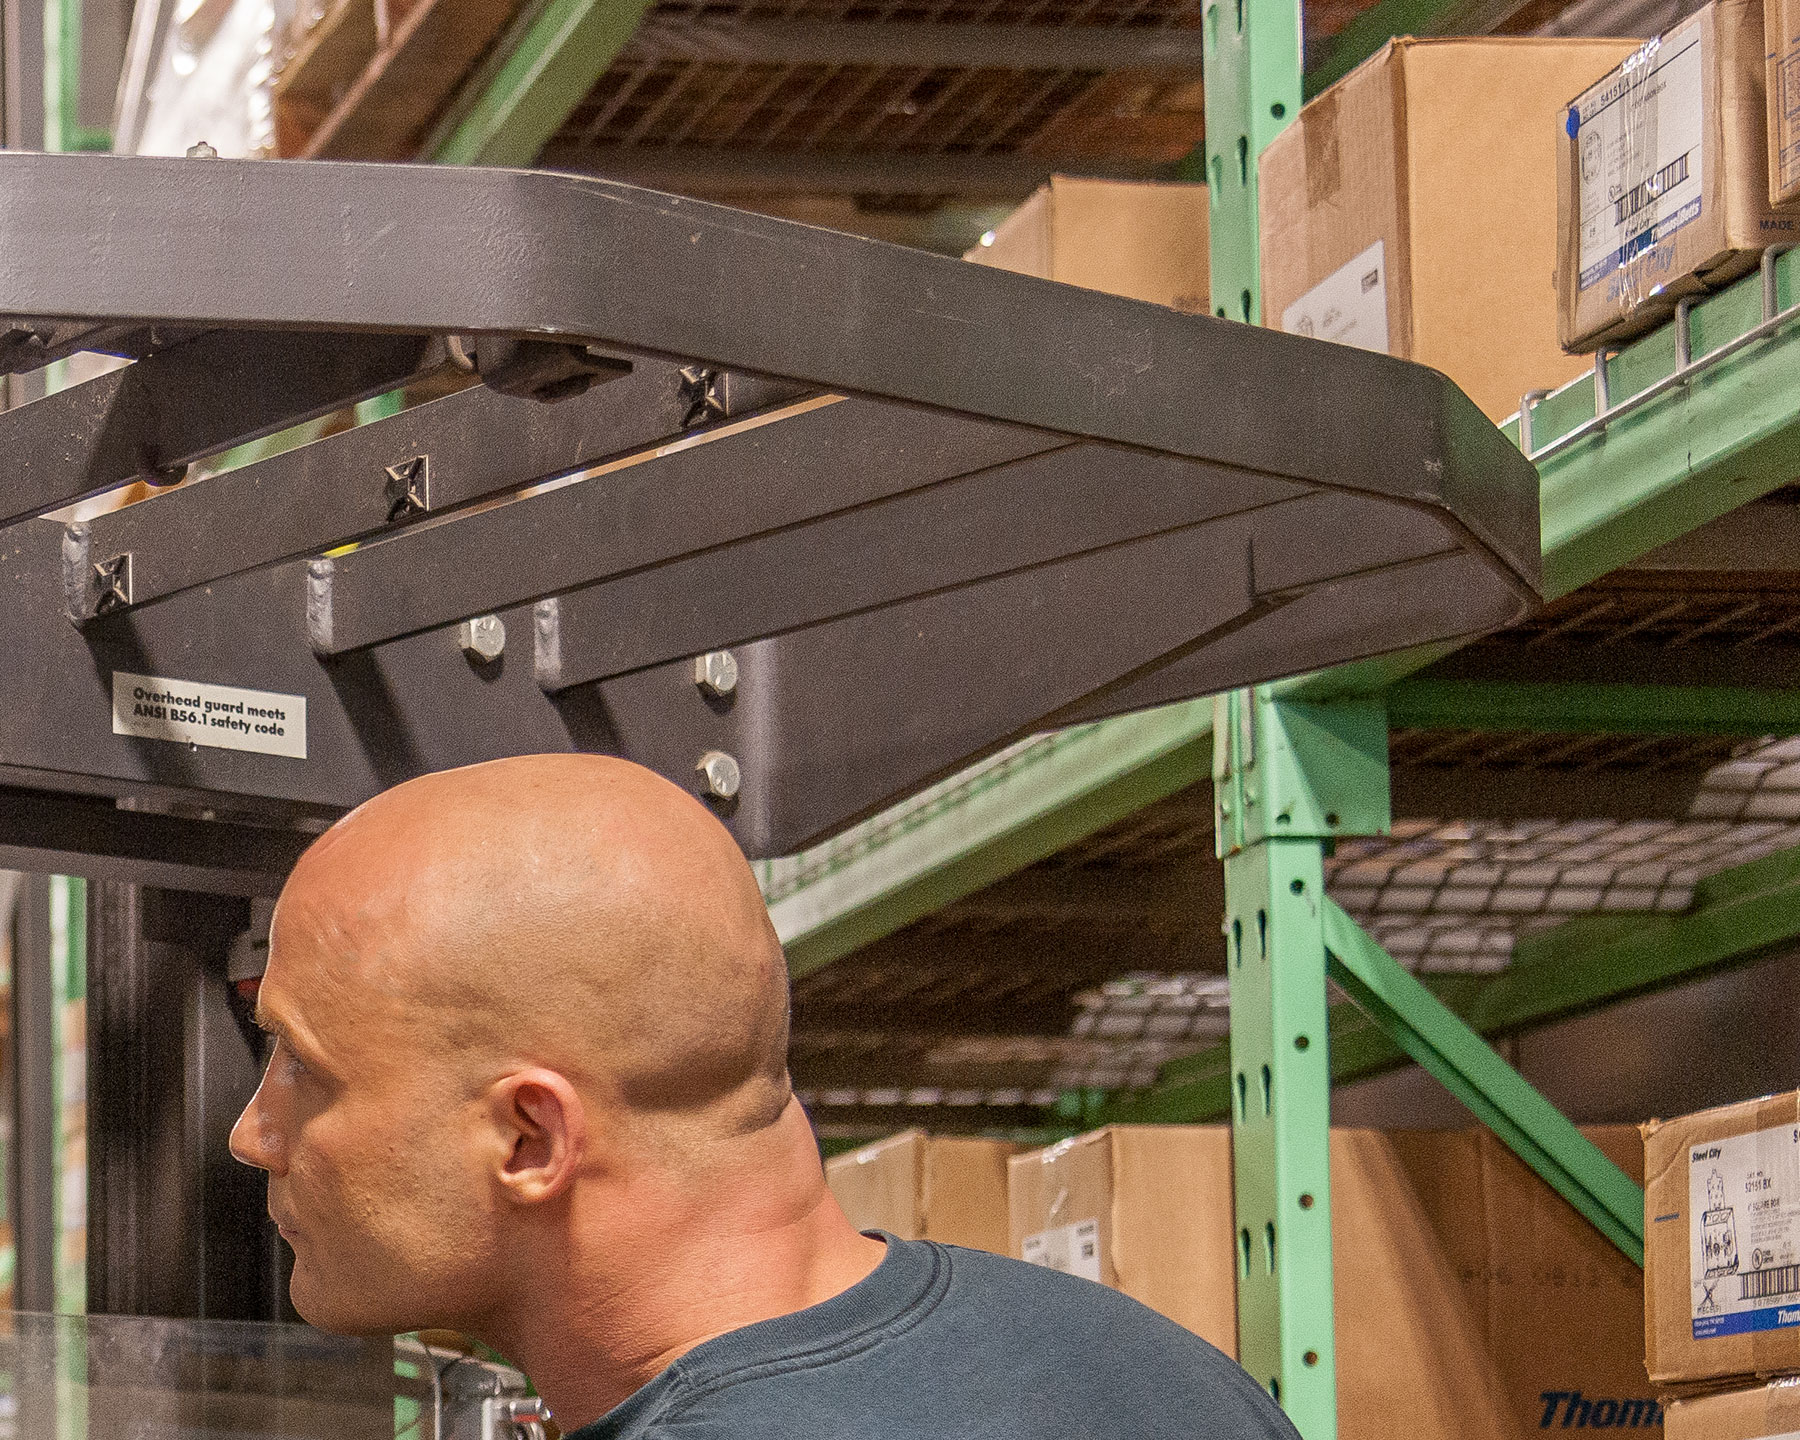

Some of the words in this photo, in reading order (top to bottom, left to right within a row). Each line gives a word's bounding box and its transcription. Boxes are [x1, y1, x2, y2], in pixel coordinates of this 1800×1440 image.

[1759, 220, 1795, 231] MADE
[133, 687, 200, 708] Overhead
[205, 700, 243, 714] guard
[247, 706, 286, 721] meets
[133, 703, 167, 720] ANSI
[170, 708, 207, 725] B56.1
[211, 716, 251, 734] safety
[255, 722, 285, 736] code
